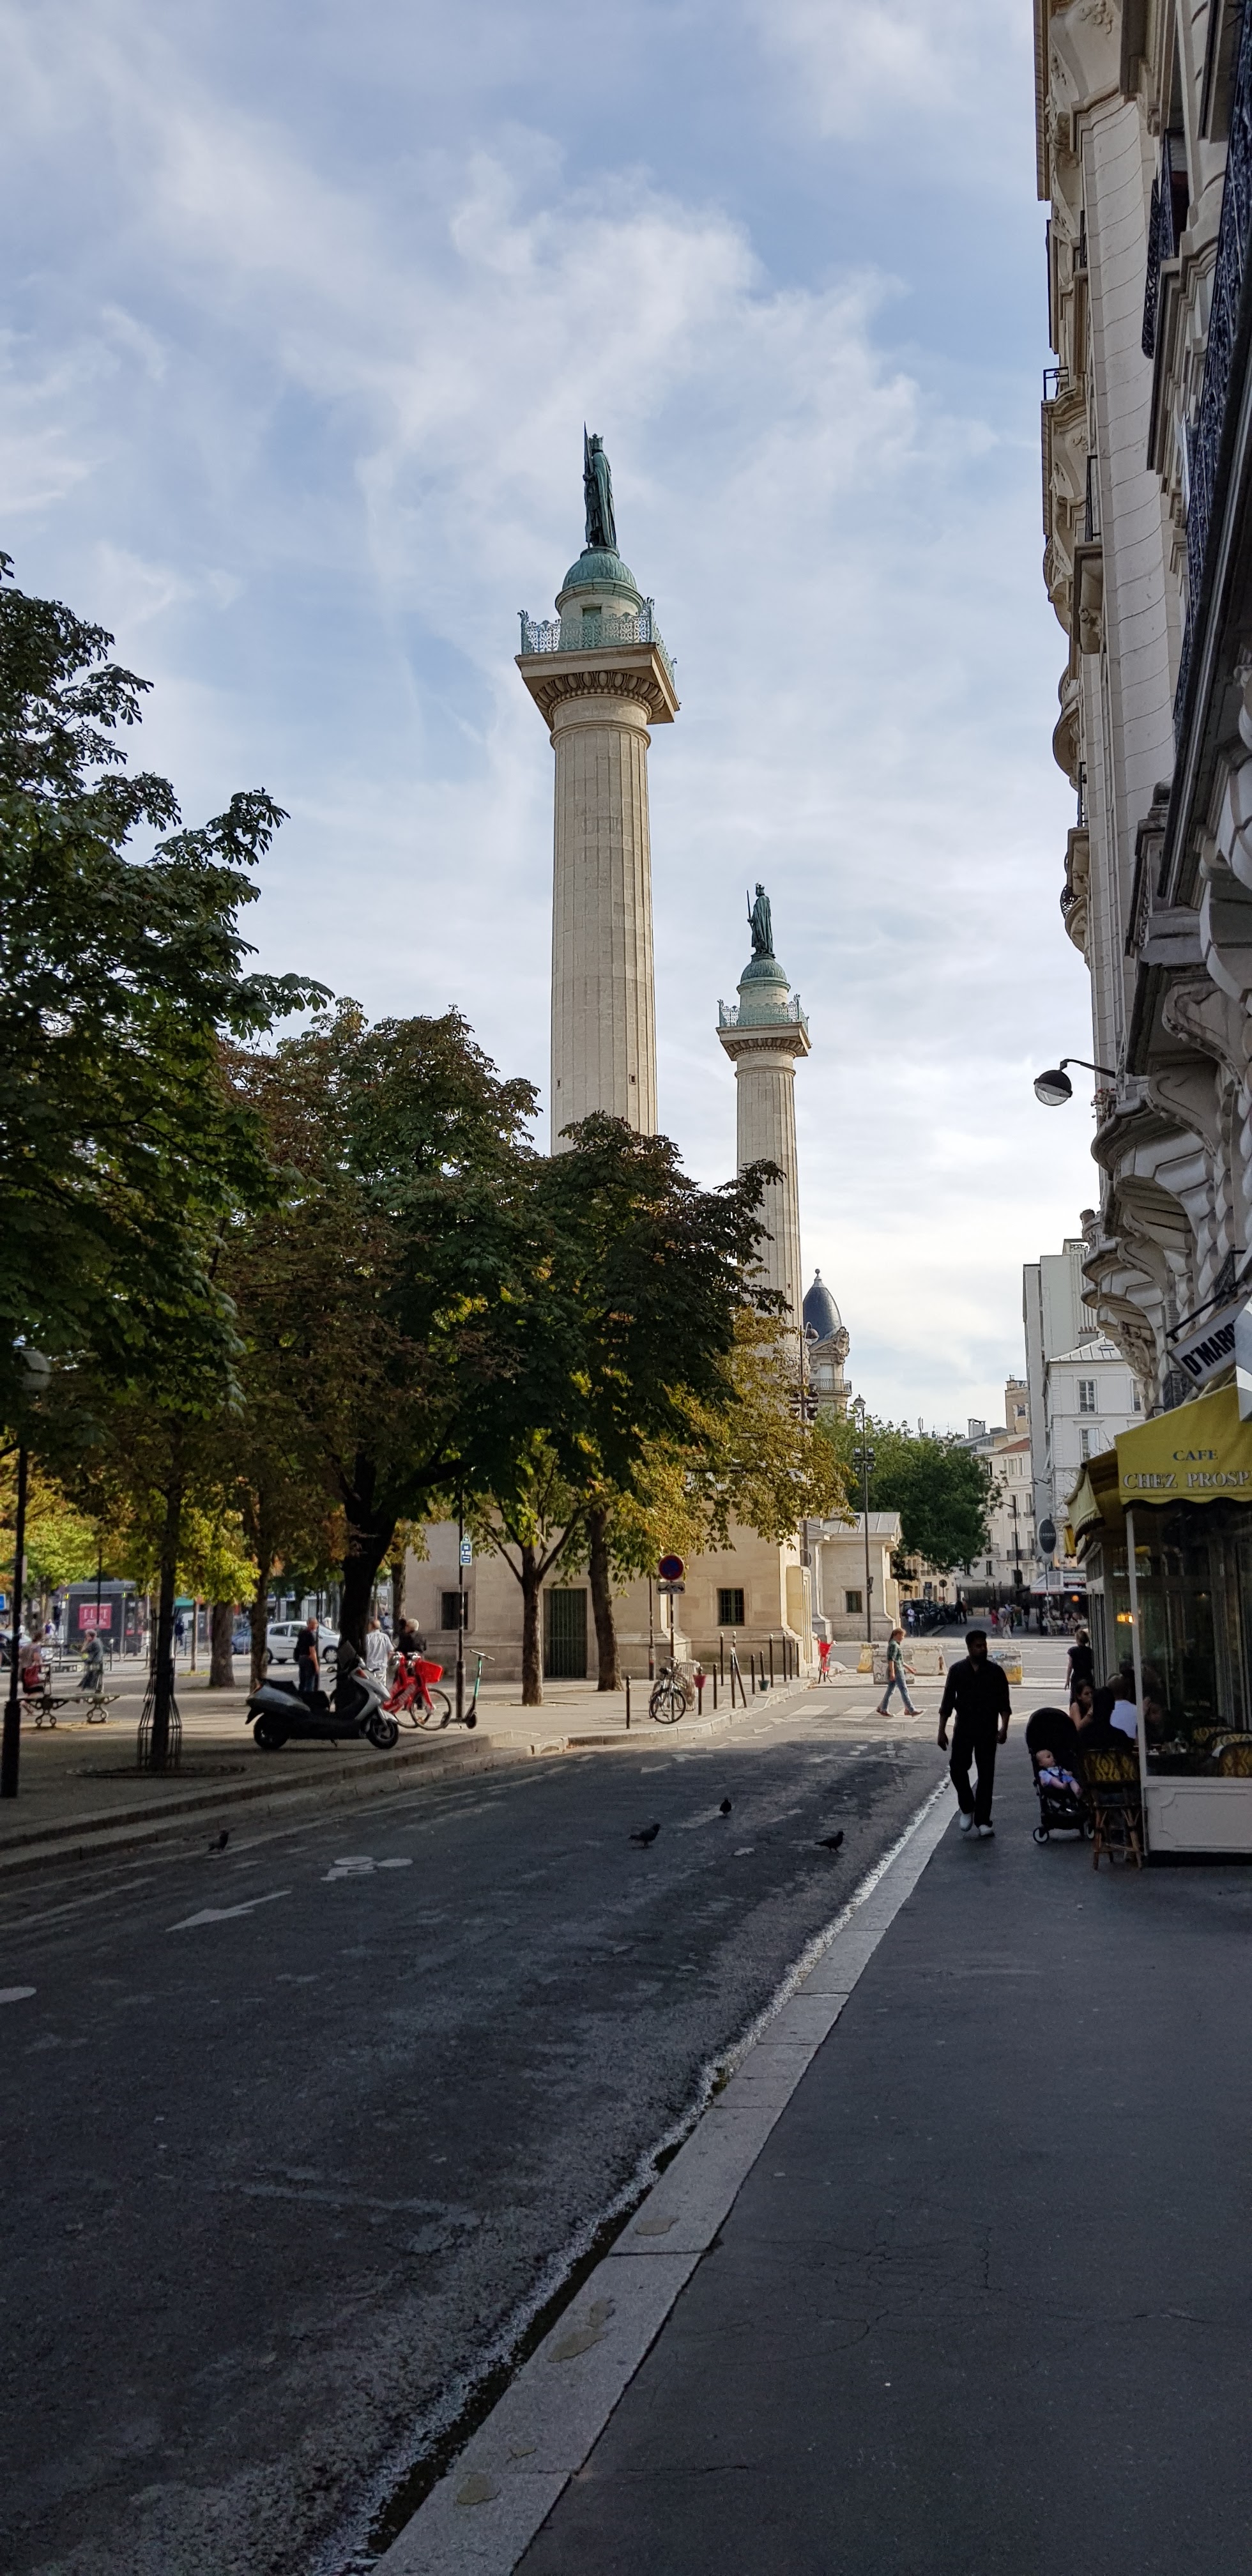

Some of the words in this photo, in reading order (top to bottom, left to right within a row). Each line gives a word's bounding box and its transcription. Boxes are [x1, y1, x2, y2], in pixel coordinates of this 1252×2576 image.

[1173, 1449, 1218, 1461] CAFE
[1123, 1473, 1177, 1488] CHEZ
[1187, 1471, 1252, 1487] PROSP
